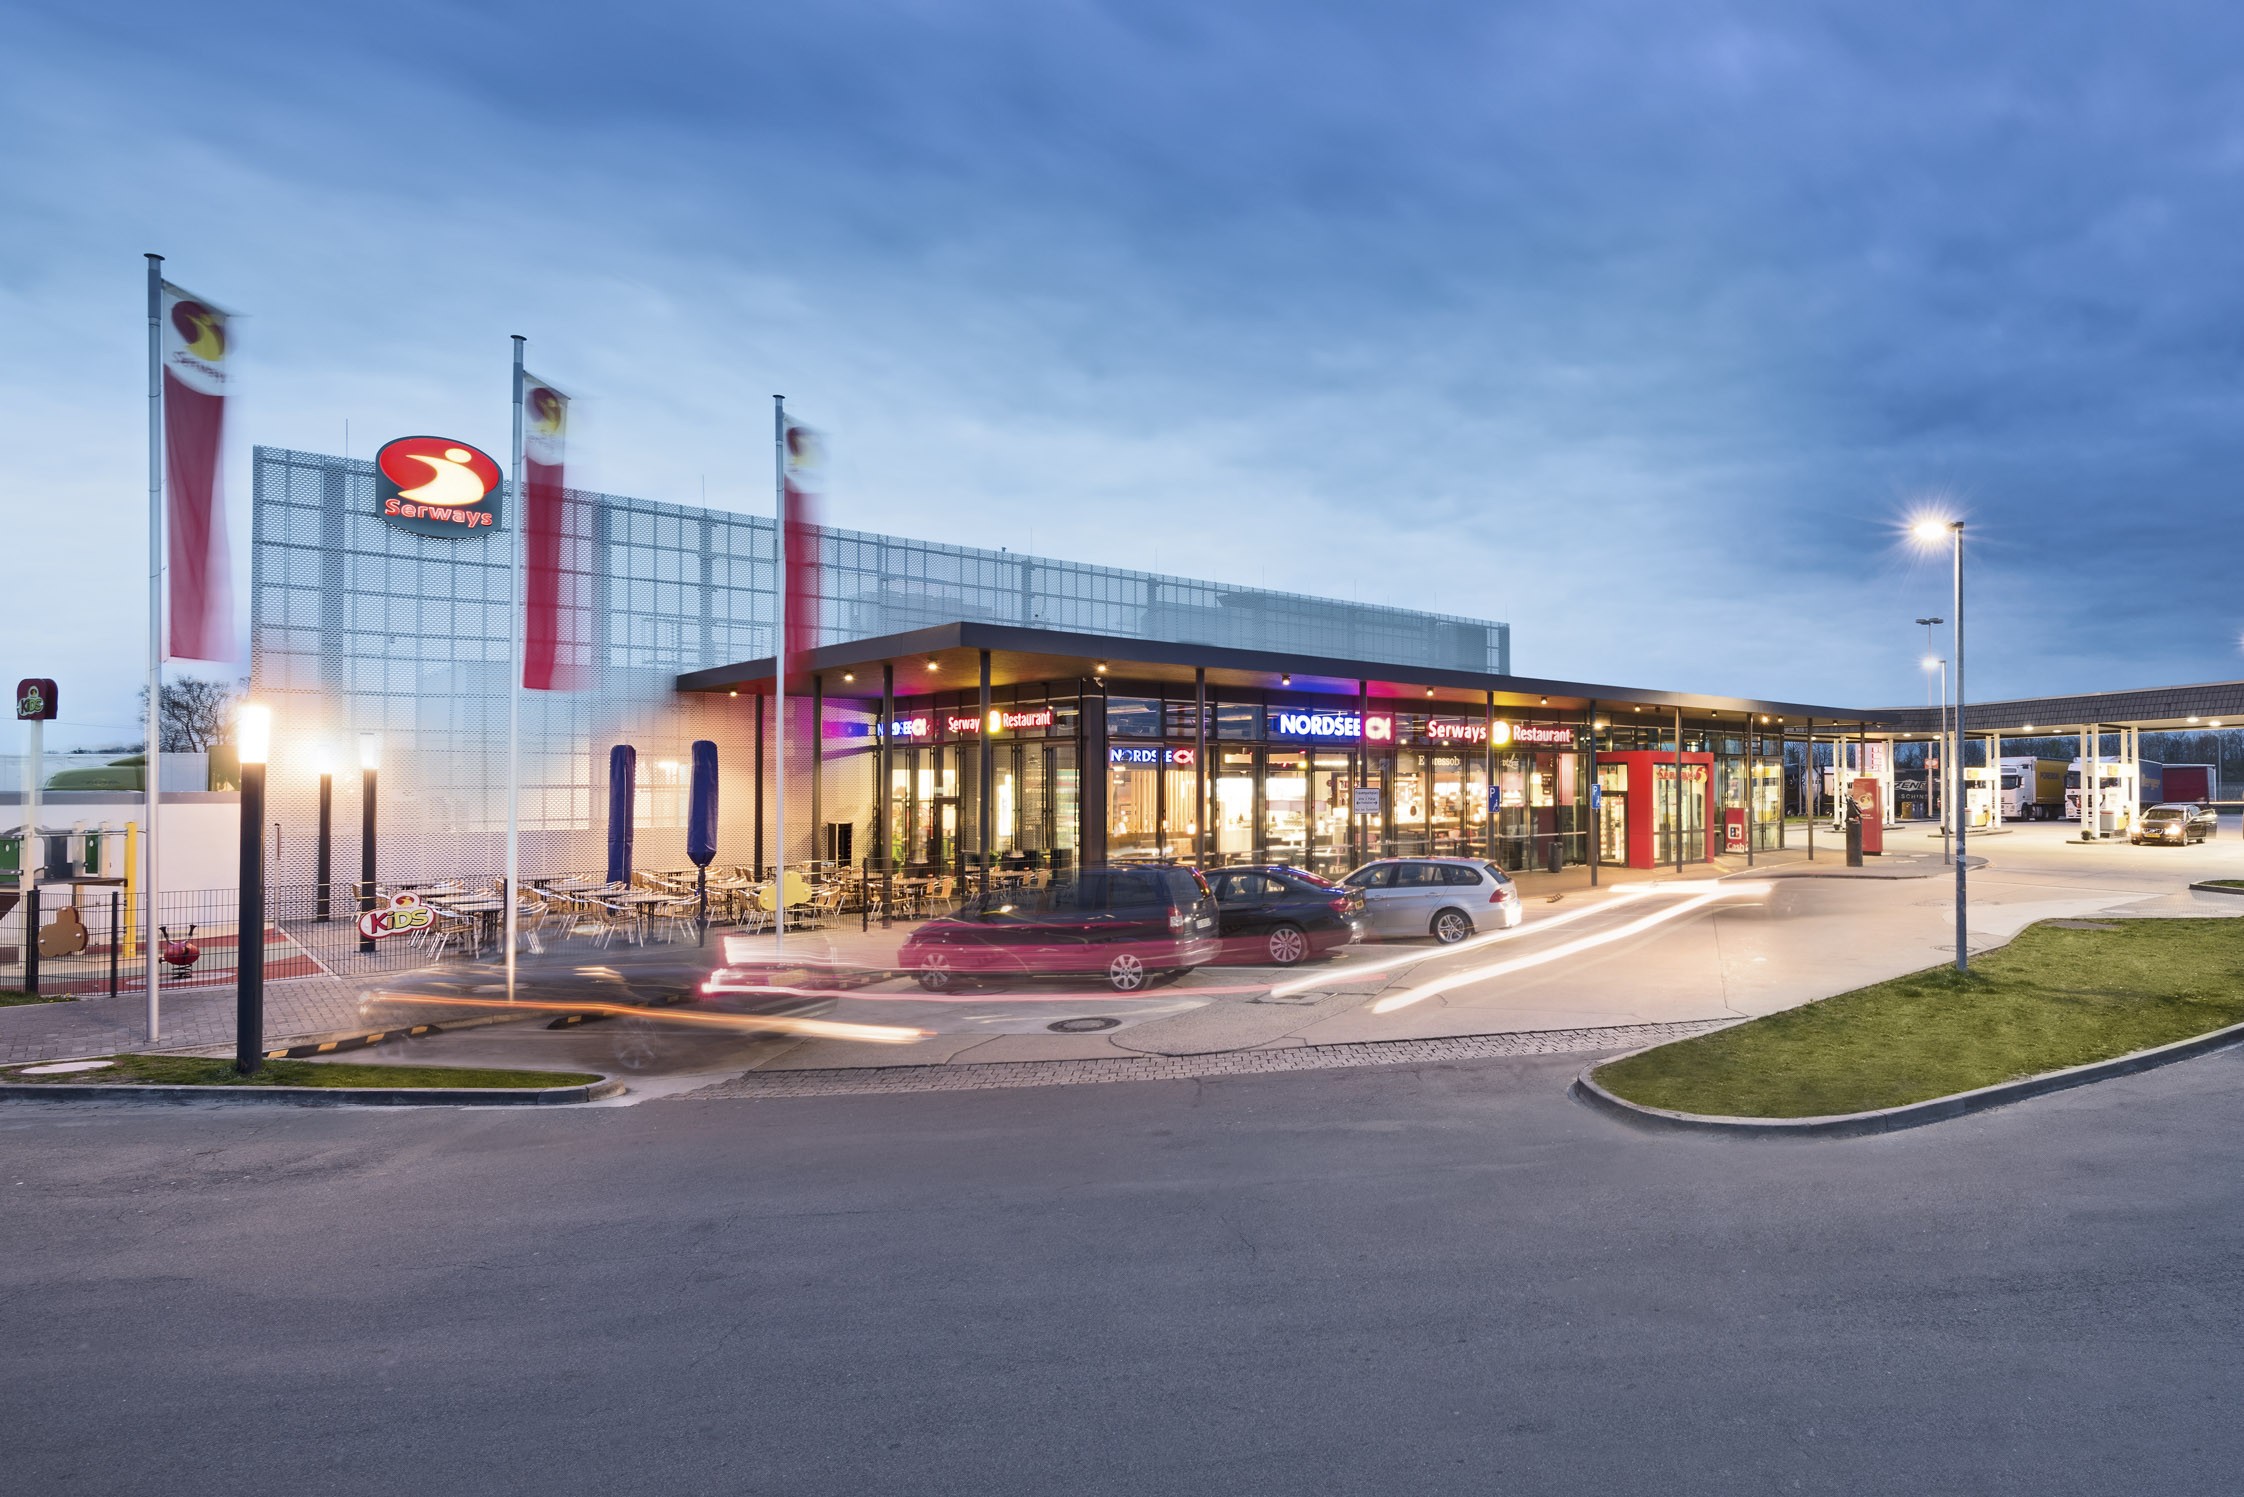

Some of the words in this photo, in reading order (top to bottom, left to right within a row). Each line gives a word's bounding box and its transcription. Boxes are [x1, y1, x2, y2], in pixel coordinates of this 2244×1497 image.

[385, 499, 493, 528] Serways
[948, 717, 980, 733] Serway
[1002, 711, 1051, 729] Restaurant
[1280, 714, 1361, 737] NORDSEE
[1428, 720, 1487, 743] Serways
[1513, 725, 1571, 743] Restaurant
[1111, 749, 1173, 763] NORDSE
[1489, 787, 1496, 798] P
[1593, 786, 1598, 796] P
